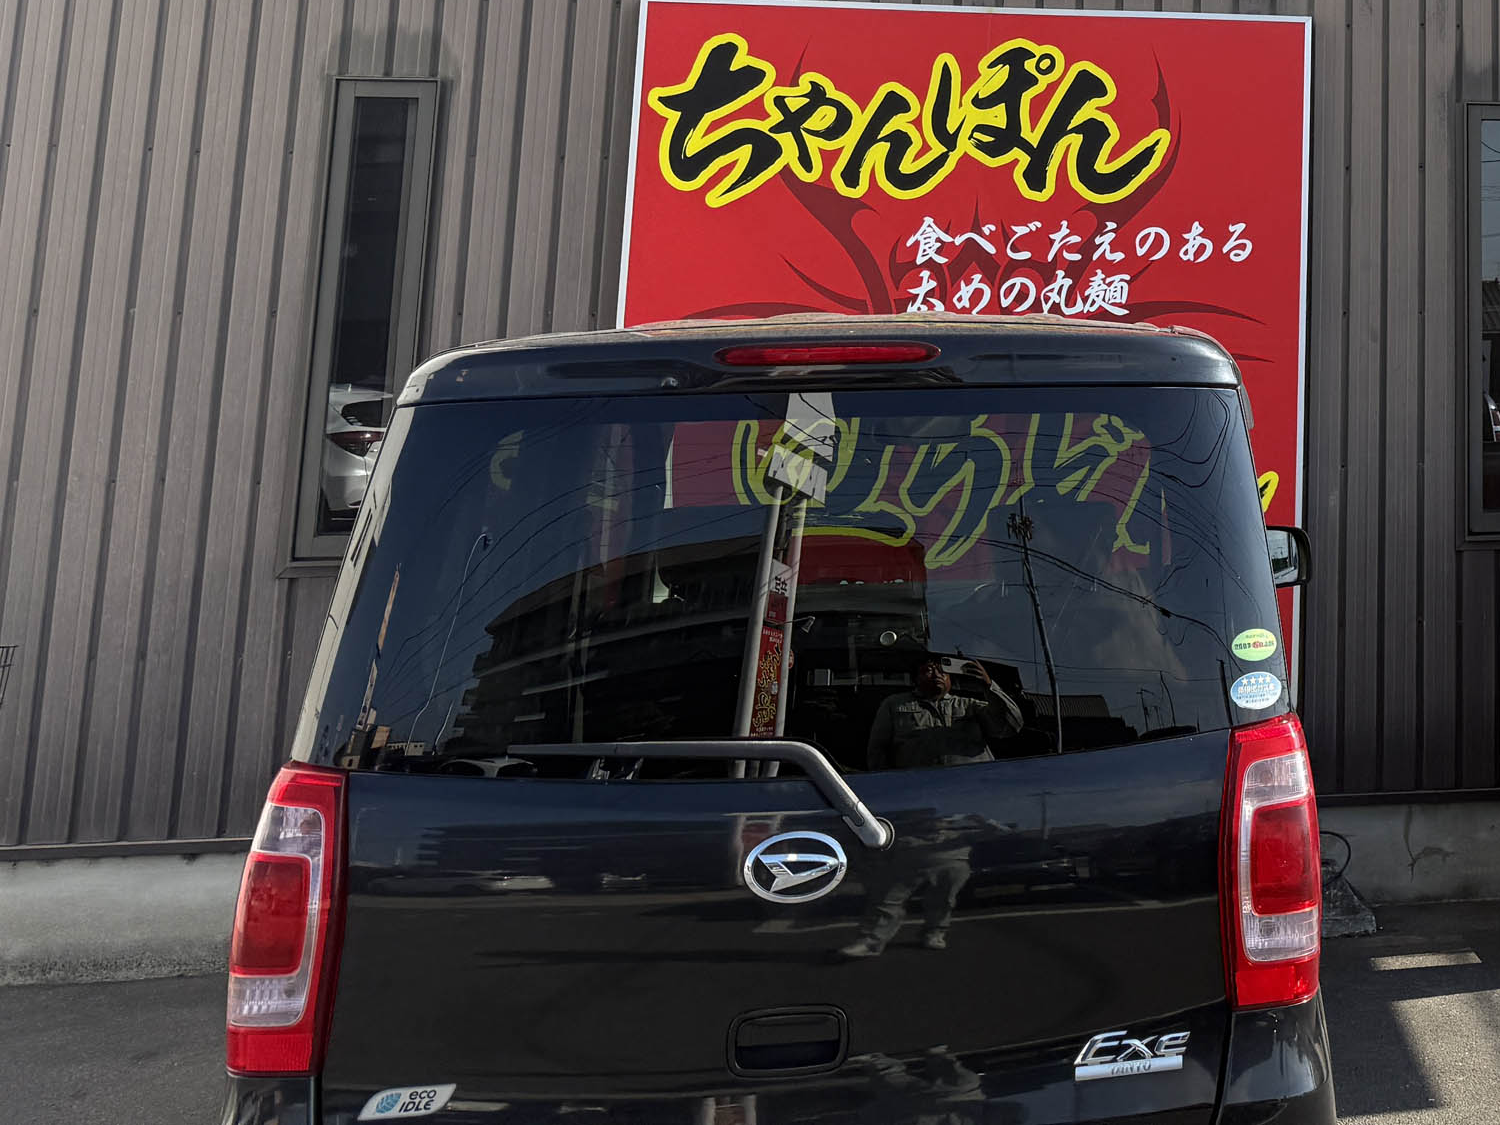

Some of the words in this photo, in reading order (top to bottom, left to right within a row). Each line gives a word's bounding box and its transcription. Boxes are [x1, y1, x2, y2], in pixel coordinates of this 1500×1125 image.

[648, 32, 1170, 208] ちゃんぽん
[906, 216, 1254, 265] 食べごたえのある
[398, 1100, 434, 1113] IDLE
[409, 1089, 437, 1100] eco
